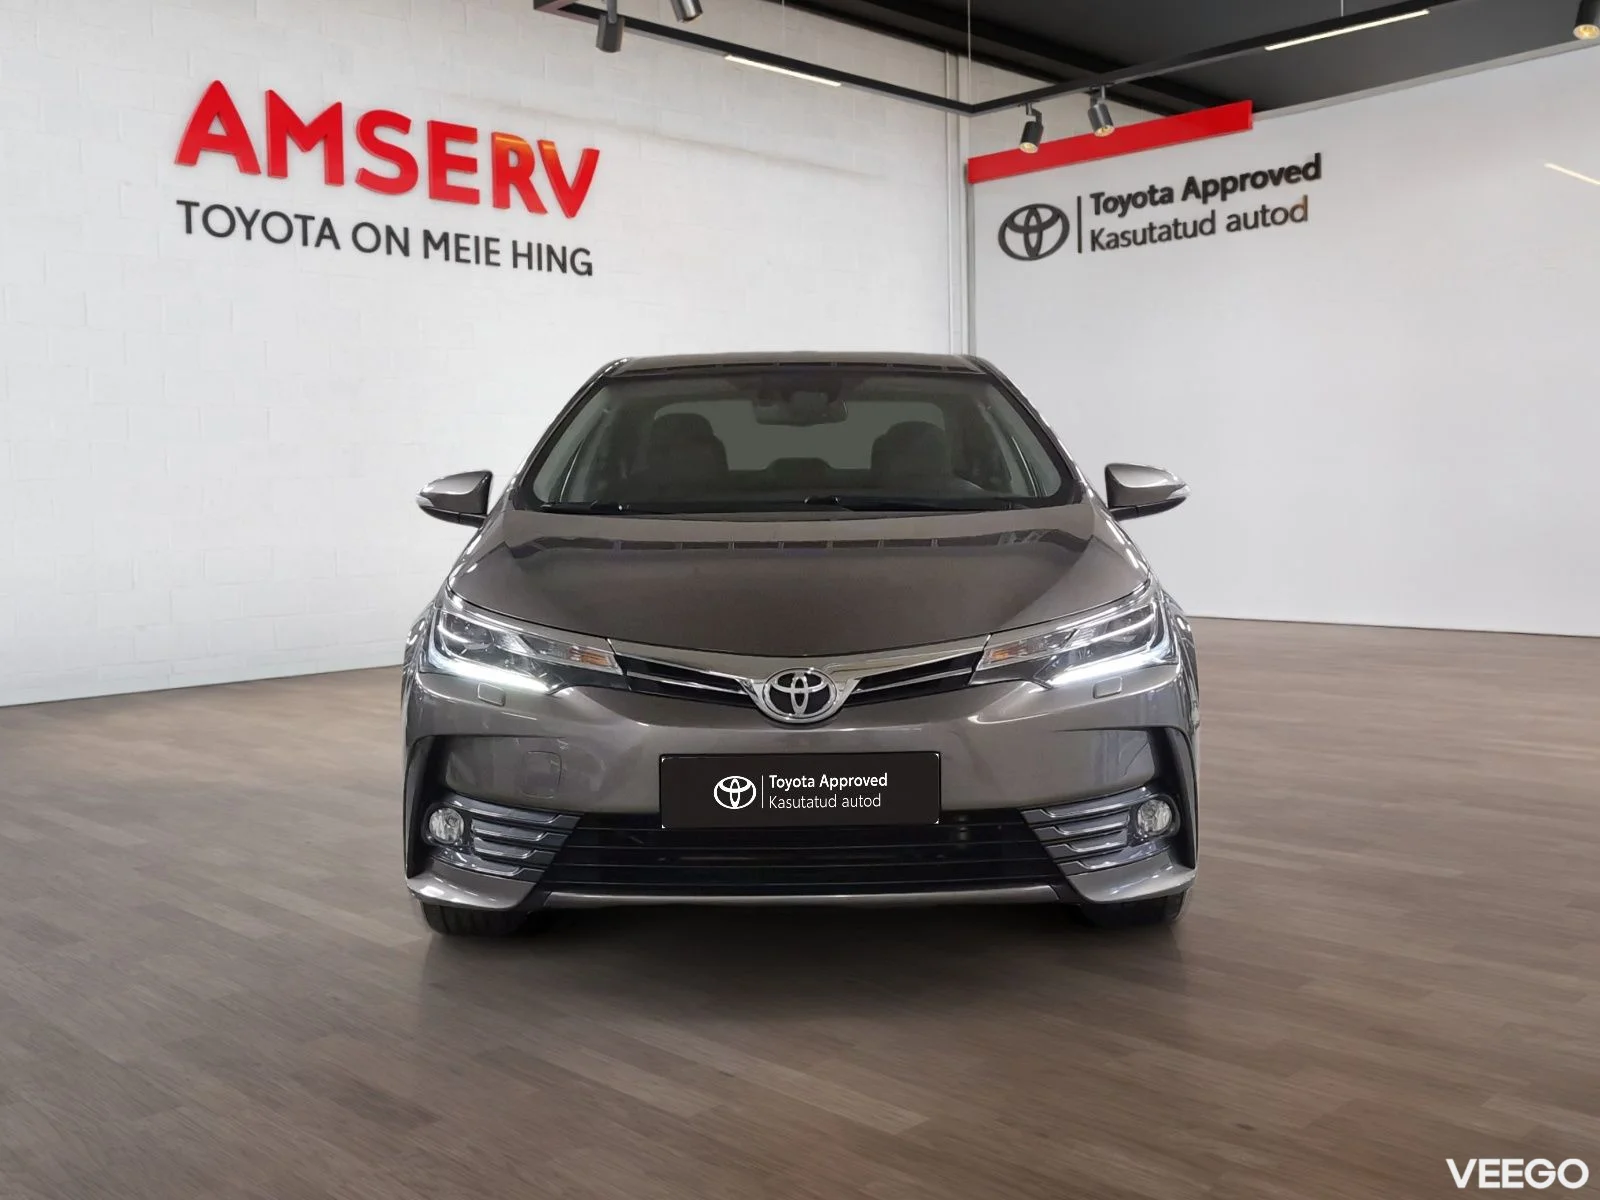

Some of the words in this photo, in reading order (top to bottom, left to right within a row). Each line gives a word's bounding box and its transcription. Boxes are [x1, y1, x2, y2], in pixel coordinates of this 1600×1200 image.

[174, 79, 600, 218] AMSERV
[1090, 185, 1174, 218] Toyota
[1181, 152, 1322, 205] Approved
[176, 199, 340, 250] TOYOTA
[351, 221, 410, 257] ON
[422, 229, 501, 267] MEIE
[512, 239, 593, 276] HING
[1090, 210, 1216, 252] Kasutatud
[1226, 195, 1309, 232] autod
[769, 774, 815, 791] Toyota
[819, 772, 888, 790] Approved
[769, 793, 837, 809] Kasutatud
[841, 793, 881, 808] autod
